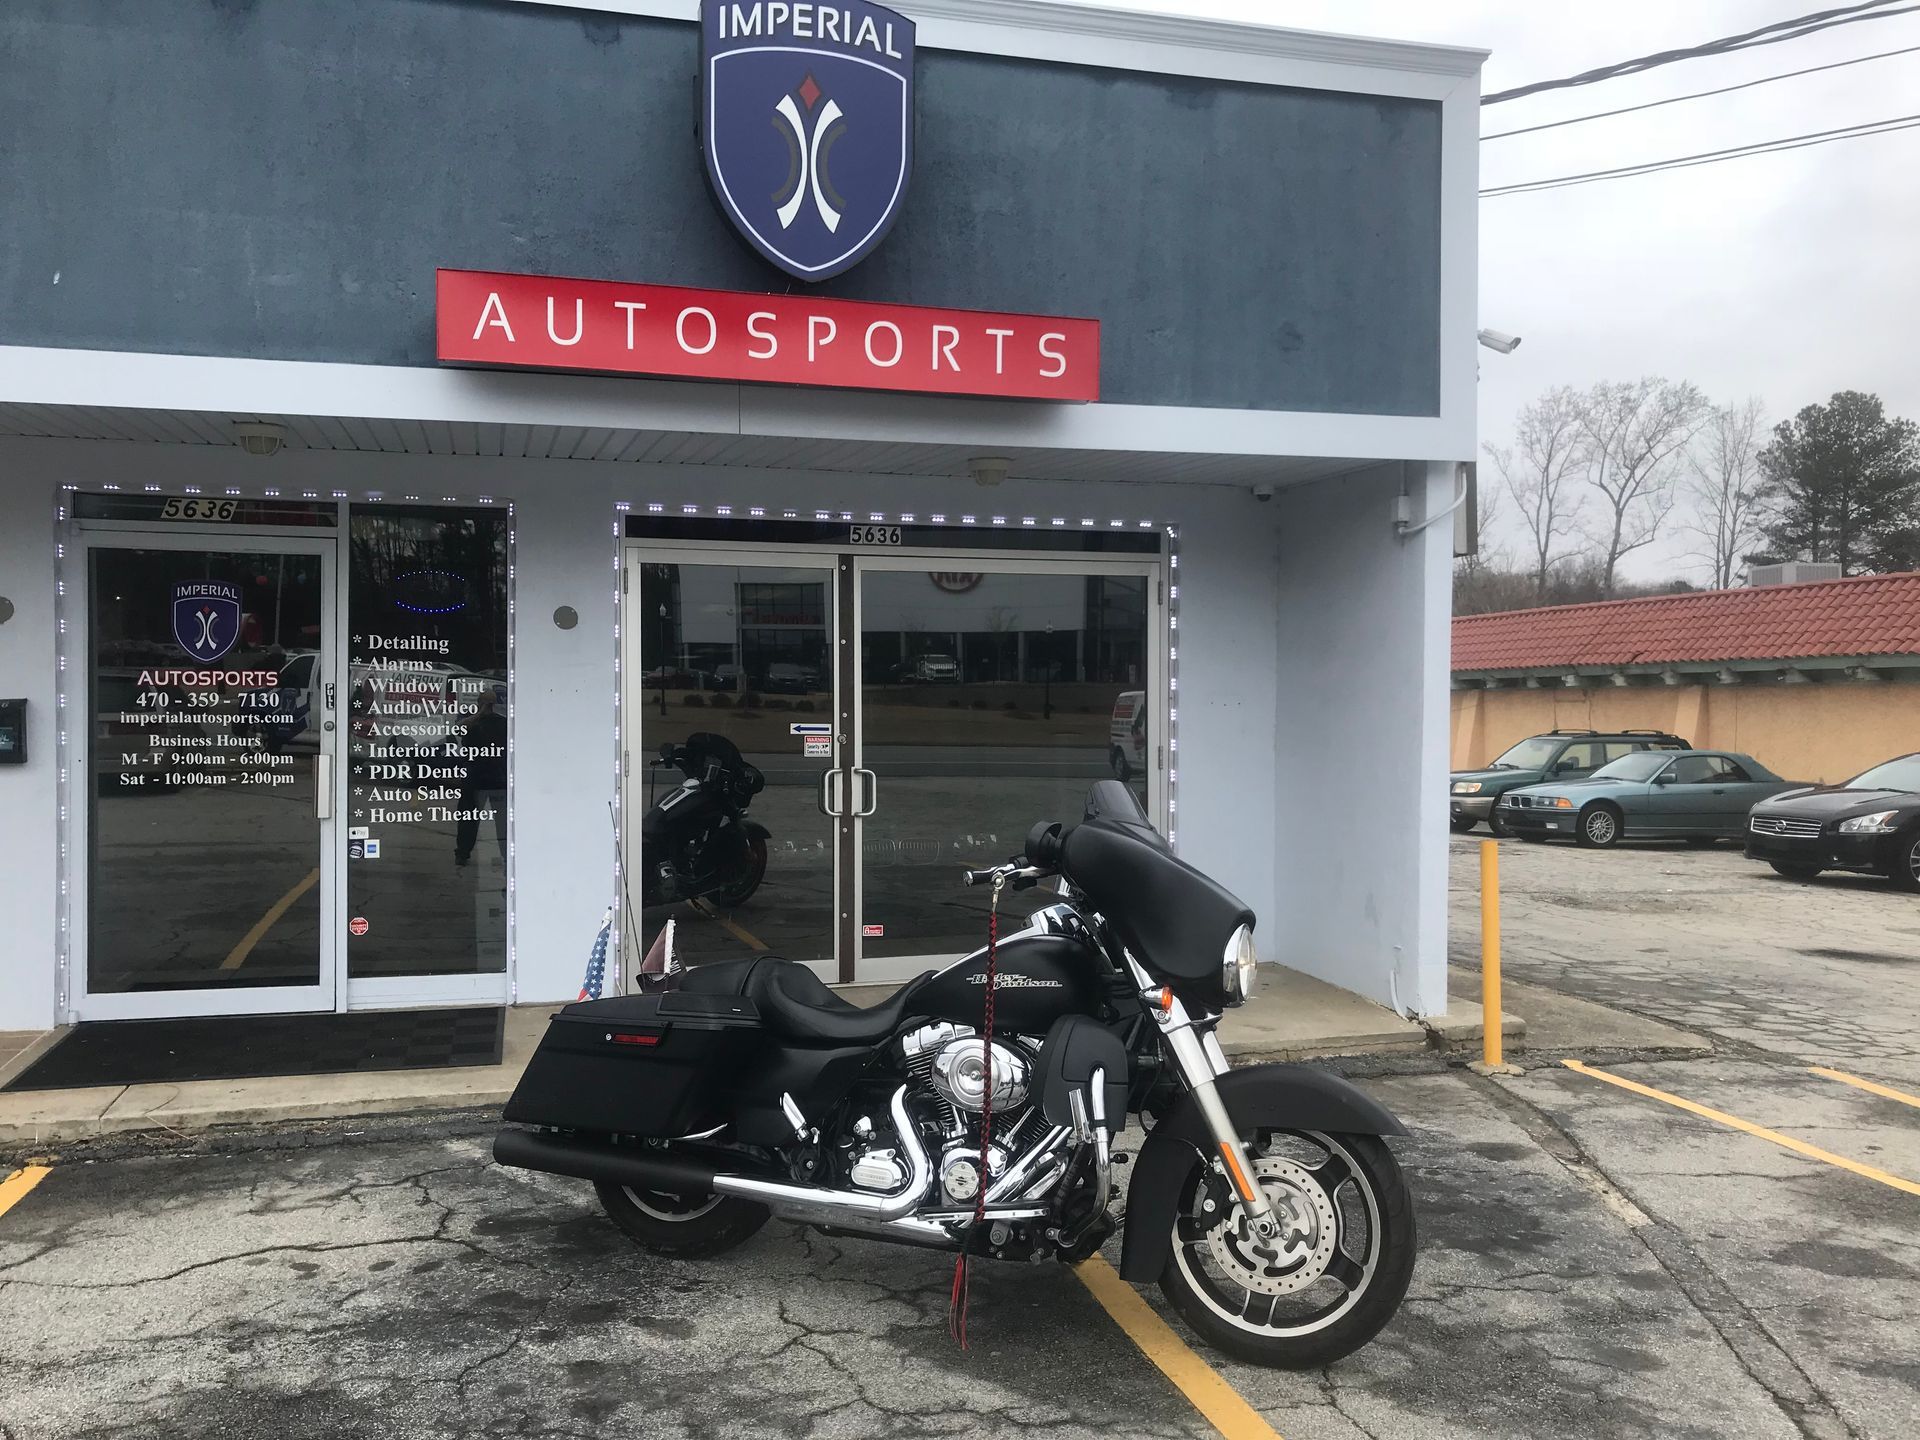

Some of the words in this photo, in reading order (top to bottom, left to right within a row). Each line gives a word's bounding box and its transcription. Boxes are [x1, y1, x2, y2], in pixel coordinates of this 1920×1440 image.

[718, 1, 903, 60] IMPERIAL
[472, 292, 1068, 378] AUTOSPORTS
[164, 500, 235, 519] 5636
[852, 526, 900, 544] 5636
[176, 584, 238, 599] IMPERIAL
[368, 634, 450, 654] Detailing
[367, 657, 433, 671] Alarms
[137, 670, 278, 686] AUTOSPORTS
[368, 677, 443, 693] Window
[447, 678, 486, 693] Tint
[136, 692, 169, 708] 470
[187, 692, 220, 707] 359
[237, 692, 280, 707] 7130
[326, 683, 334, 709] PULL
[367, 697, 479, 718] Audio\Video
[120, 711, 294, 726] imperialautosports.com
[367, 721, 468, 736] Accessories
[149, 734, 212, 747] Business
[216, 734, 261, 747] Hours
[368, 743, 439, 758] Interior
[444, 742, 505, 761] Repair
[121, 753, 138, 765] M
[153, 753, 164, 765] F
[171, 753, 226, 765] 9:00am
[240, 753, 294, 767] 6:00pm
[120, 772, 145, 785] Sat
[164, 773, 226, 785] 10:00am
[240, 772, 295, 787] 2:00pm
[369, 765, 412, 780] PDR
[417, 765, 468, 779] Dents
[367, 787, 412, 802] Auto
[417, 785, 462, 800] Sales
[370, 808, 423, 823] Home
[427, 806, 498, 822] Theater
